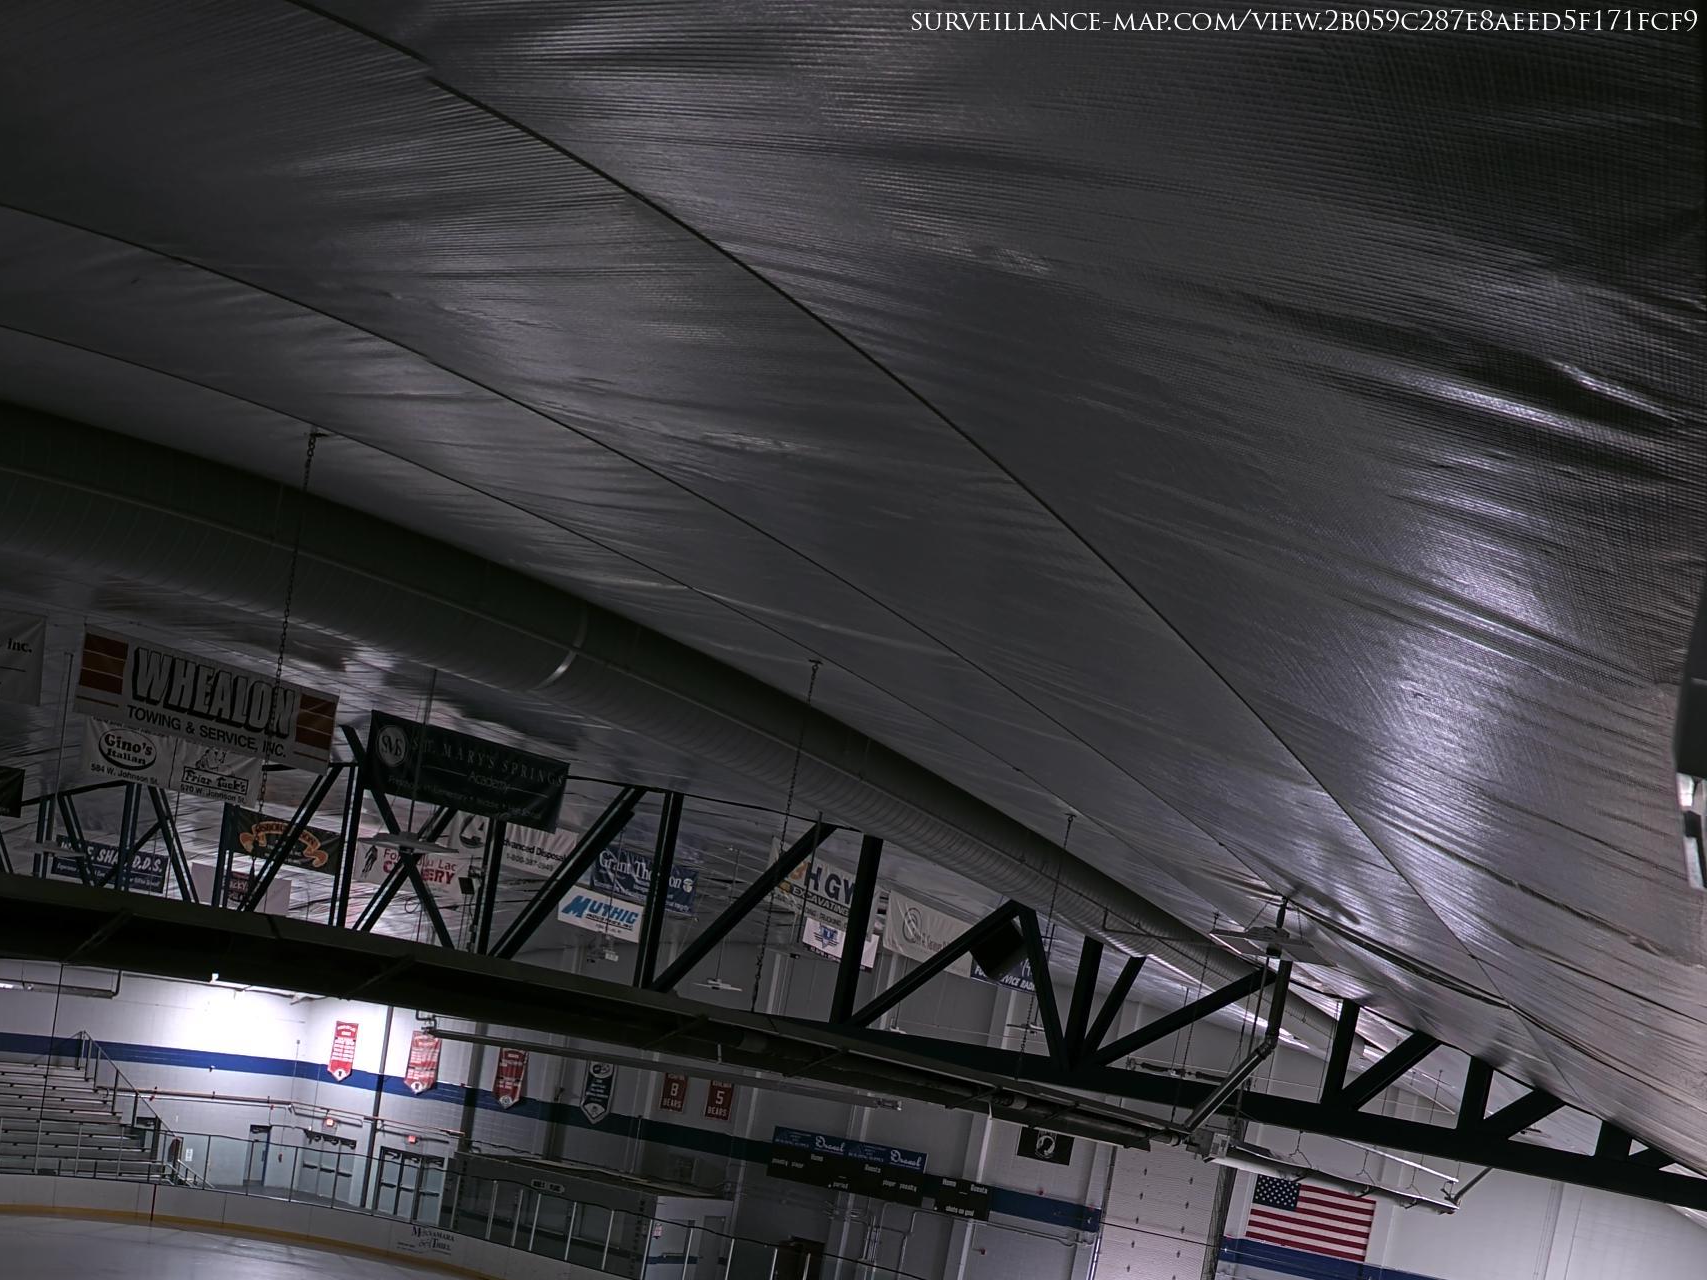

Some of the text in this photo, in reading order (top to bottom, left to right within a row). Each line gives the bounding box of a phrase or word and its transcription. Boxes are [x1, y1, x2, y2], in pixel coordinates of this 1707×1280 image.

[8, 638, 33, 653] inc.
[134, 648, 296, 738] WHEALON
[104, 734, 152, 756] Gino's
[128, 705, 181, 732] TOWING
[185, 722, 195, 734] &
[199, 725, 258, 752] SERVICE,
[262, 740, 286, 758] INC.
